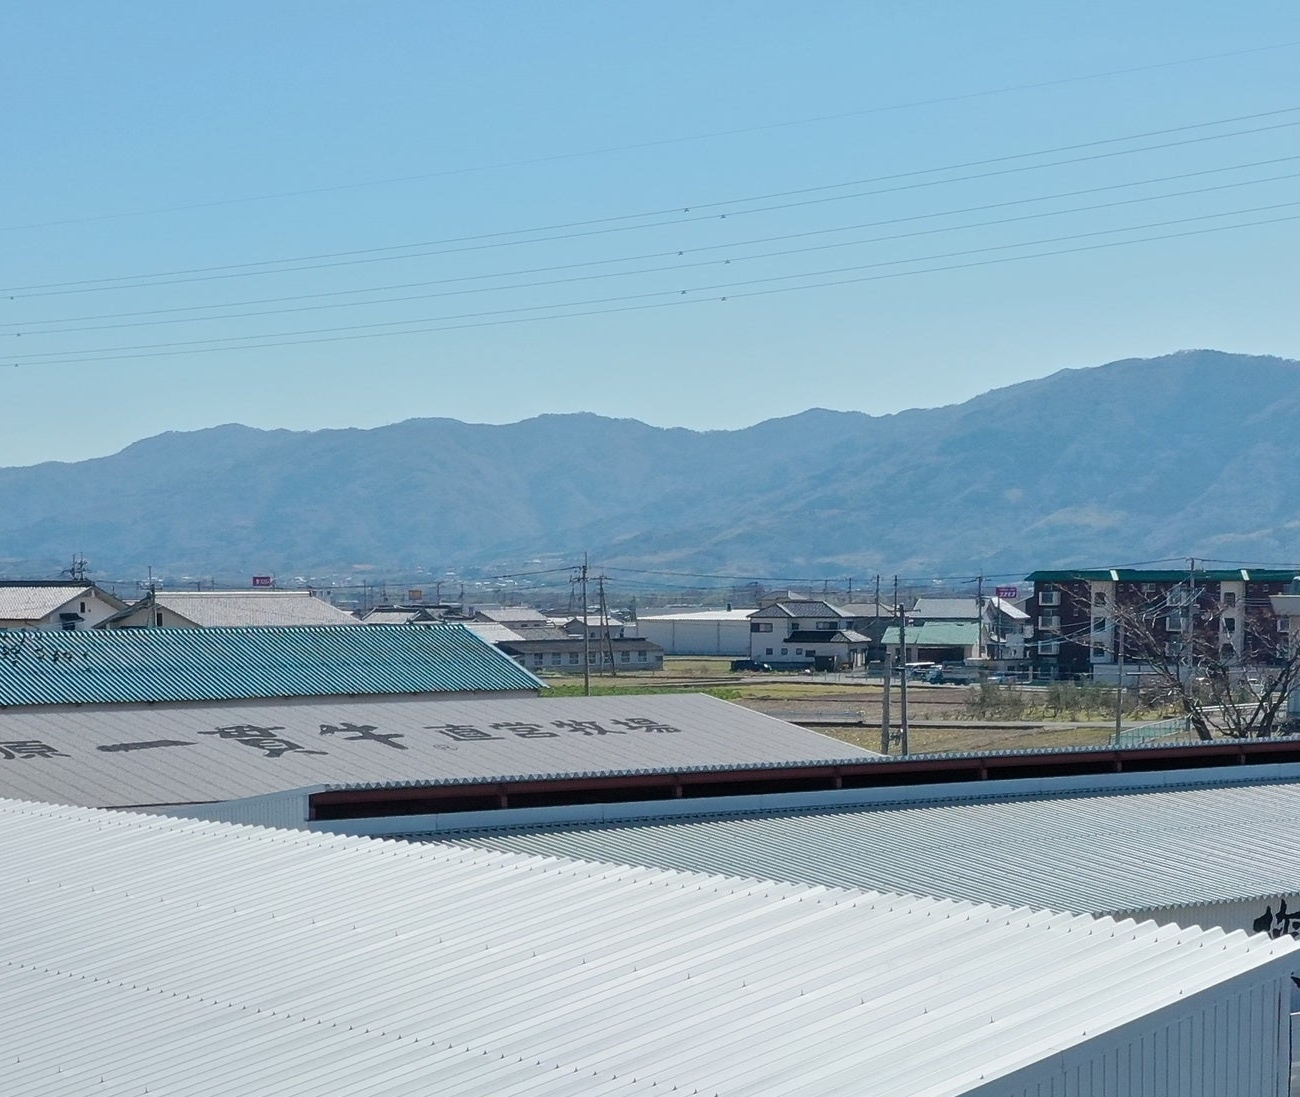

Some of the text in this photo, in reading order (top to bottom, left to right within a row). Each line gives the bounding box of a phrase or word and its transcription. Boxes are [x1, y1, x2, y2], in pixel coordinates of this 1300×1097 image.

[96, 722, 409, 758] 一貫牛
[422, 717, 683, 741] 直営牧場
